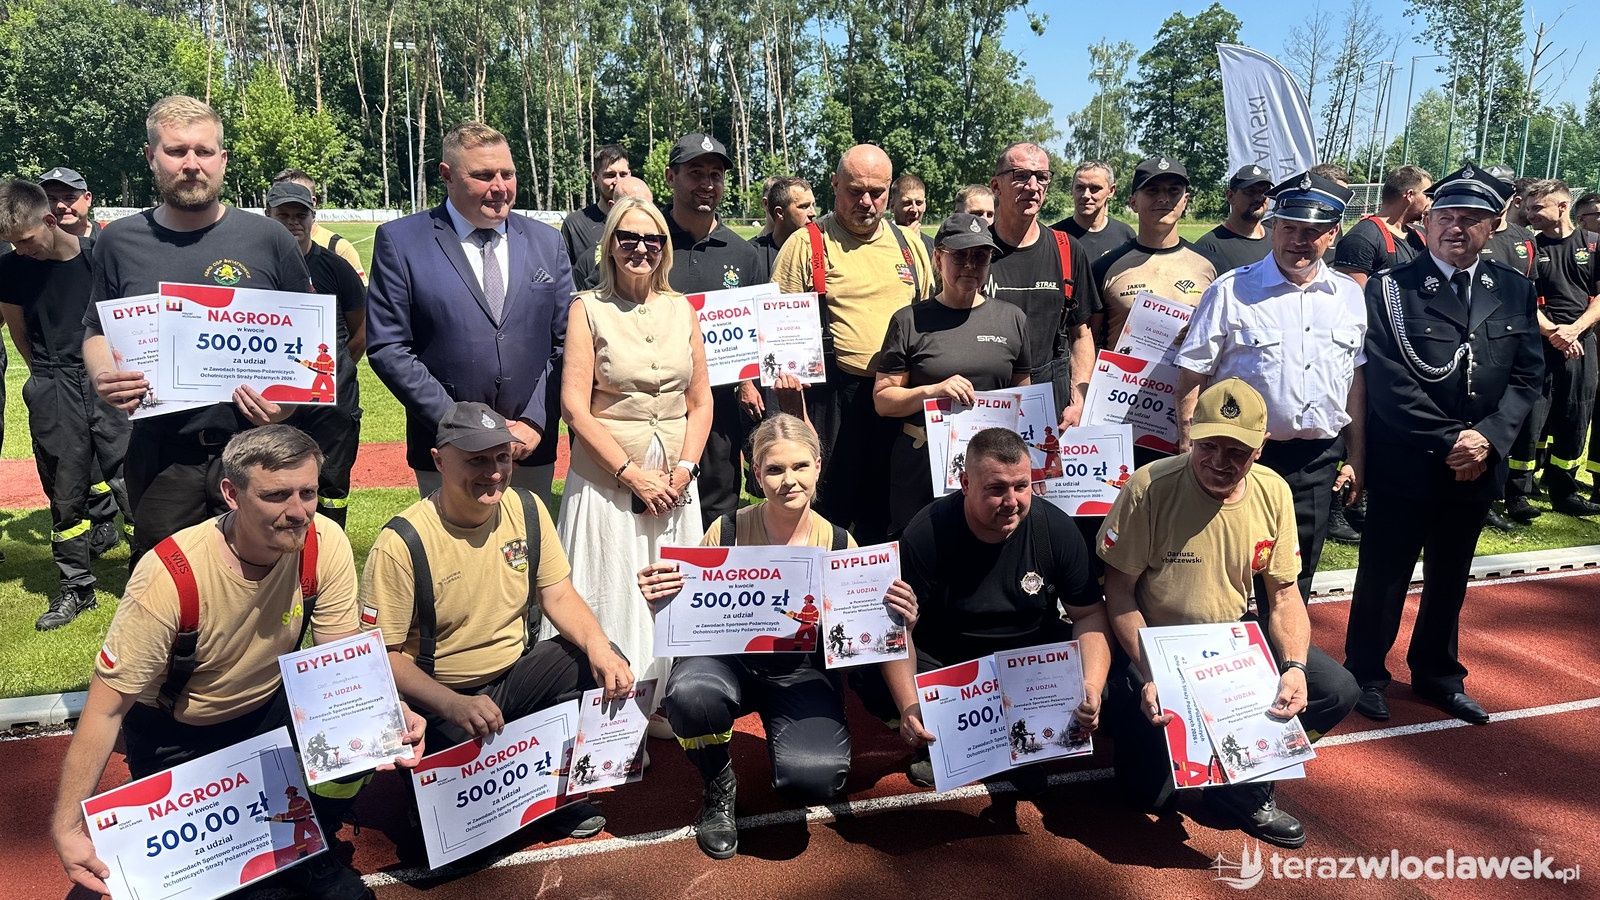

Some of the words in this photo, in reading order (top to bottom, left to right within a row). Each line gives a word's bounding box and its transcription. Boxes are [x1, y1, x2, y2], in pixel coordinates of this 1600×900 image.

[112, 303, 160, 320] DYPL
[764, 300, 810, 310] DYPLOM
[1143, 300, 1190, 322] DYPLOM
[208, 310, 292, 326] NAGRODA
[699, 306, 752, 322] AGRODA
[196, 333, 277, 354] 500,00
[284, 337, 303, 354] zł
[702, 327, 744, 345] 0,00
[748, 329, 757, 338] z
[976, 399, 1011, 409] PLOM
[1108, 389, 1164, 412] 500,00
[1166, 407, 1176, 417] z
[1021, 424, 1034, 440] zł
[1061, 445, 1098, 455] RODA
[1093, 461, 1107, 476] zł
[171, 551, 189, 574] WUS
[831, 553, 890, 570] DYPLOM
[702, 568, 781, 581] NAGRODA
[690, 591, 765, 610] 500,00
[771, 589, 790, 606] zł
[296, 643, 371, 674] DYPLOM
[1007, 651, 1068, 668] DYPLOM
[1195, 656, 1256, 681] DYPLOM
[335, 684, 363, 696] UDZIAŁ
[1234, 690, 1256, 700] UDZIAŁ
[957, 704, 1003, 731] 500,
[461, 736, 539, 779] NAGRODA
[496, 760, 515, 772] kwocie
[456, 763, 528, 808] 500,00
[534, 751, 552, 772] zł
[148, 772, 249, 821] NAGRODA
[501, 786, 521, 801] udział
[195, 800, 220, 814] kwocie
[146, 805, 239, 857] 500,00
[247, 791, 269, 818] zł
[207, 834, 233, 850] udział
[163, 869, 204, 888] Ochotniczych
[205, 860, 224, 870] Straży
[225, 847, 256, 862] Pożarnych
[256, 841, 269, 850] 2026
[171, 861, 202, 877] Zawodach
